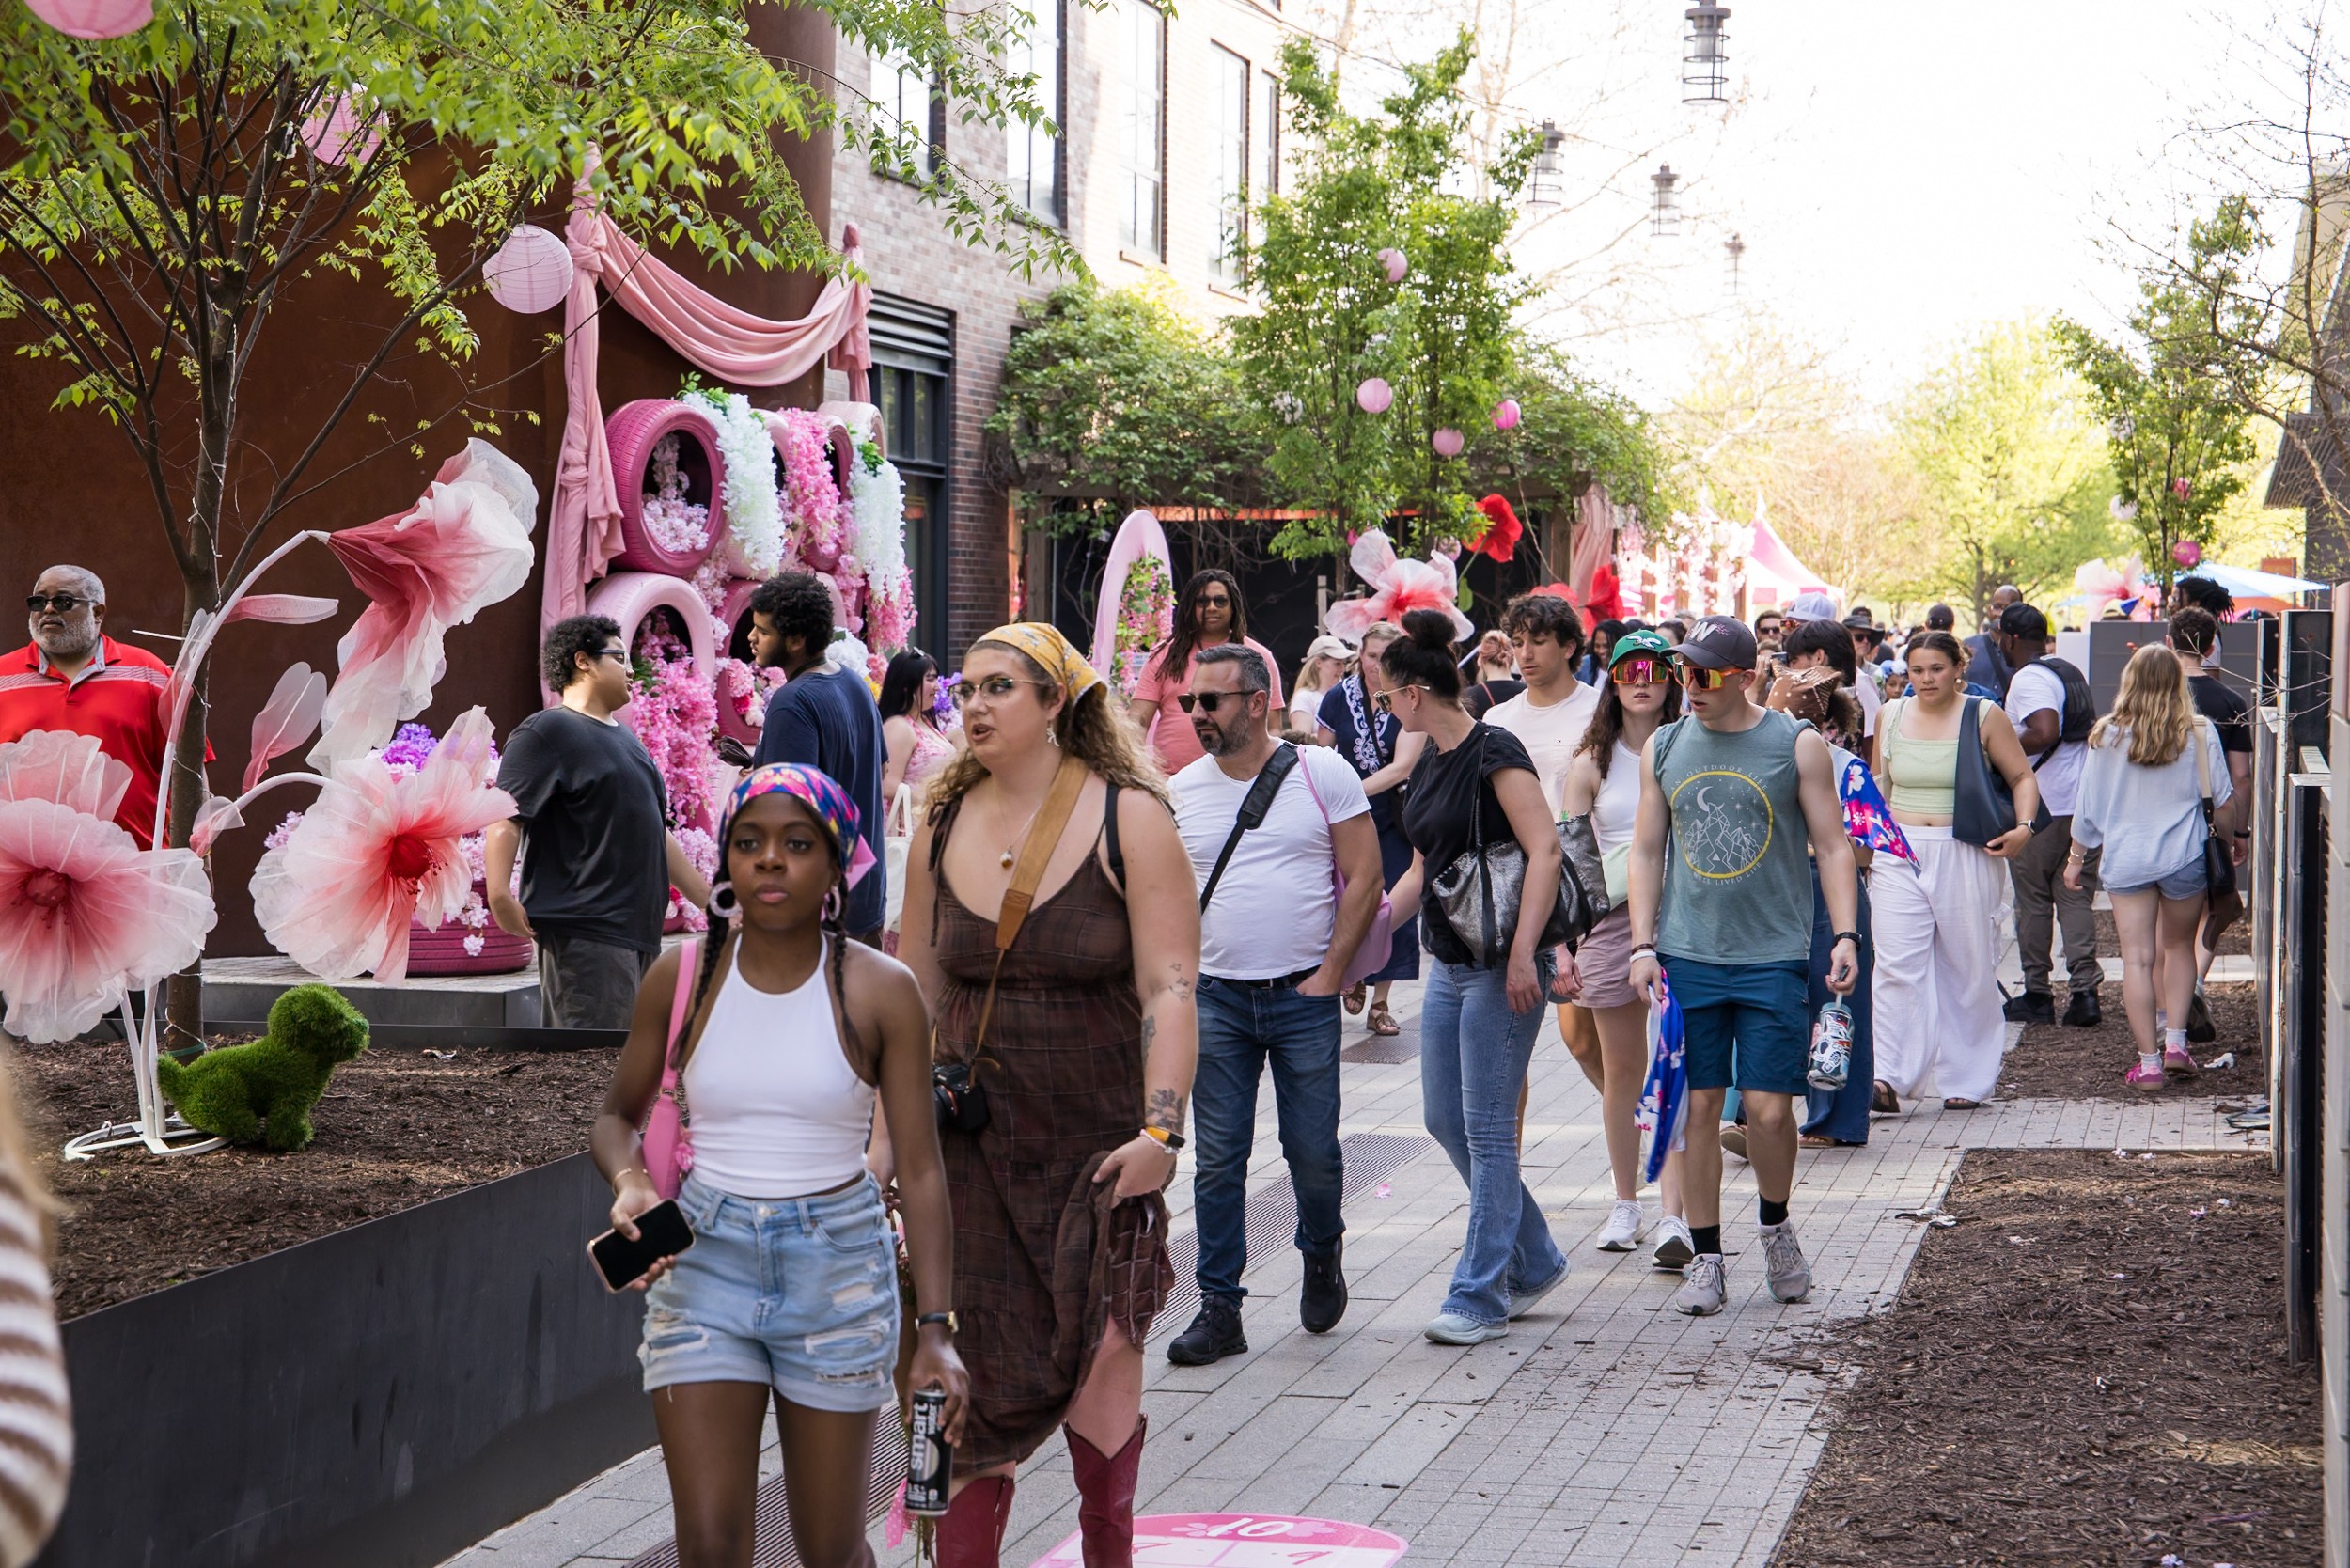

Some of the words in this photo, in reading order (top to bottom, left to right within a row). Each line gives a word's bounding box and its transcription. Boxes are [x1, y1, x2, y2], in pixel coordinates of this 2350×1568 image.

[1689, 621, 1717, 642] W
[1686, 764, 1743, 777] OUTDOOR
[1747, 772, 1768, 791] LIFE
[1716, 876, 1743, 886] LIVED
[1746, 863, 1762, 878] LIFE
[928, 1403, 938, 1435] water
[911, 1403, 928, 1470] smart
[1207, 1517, 1295, 1537] 10
